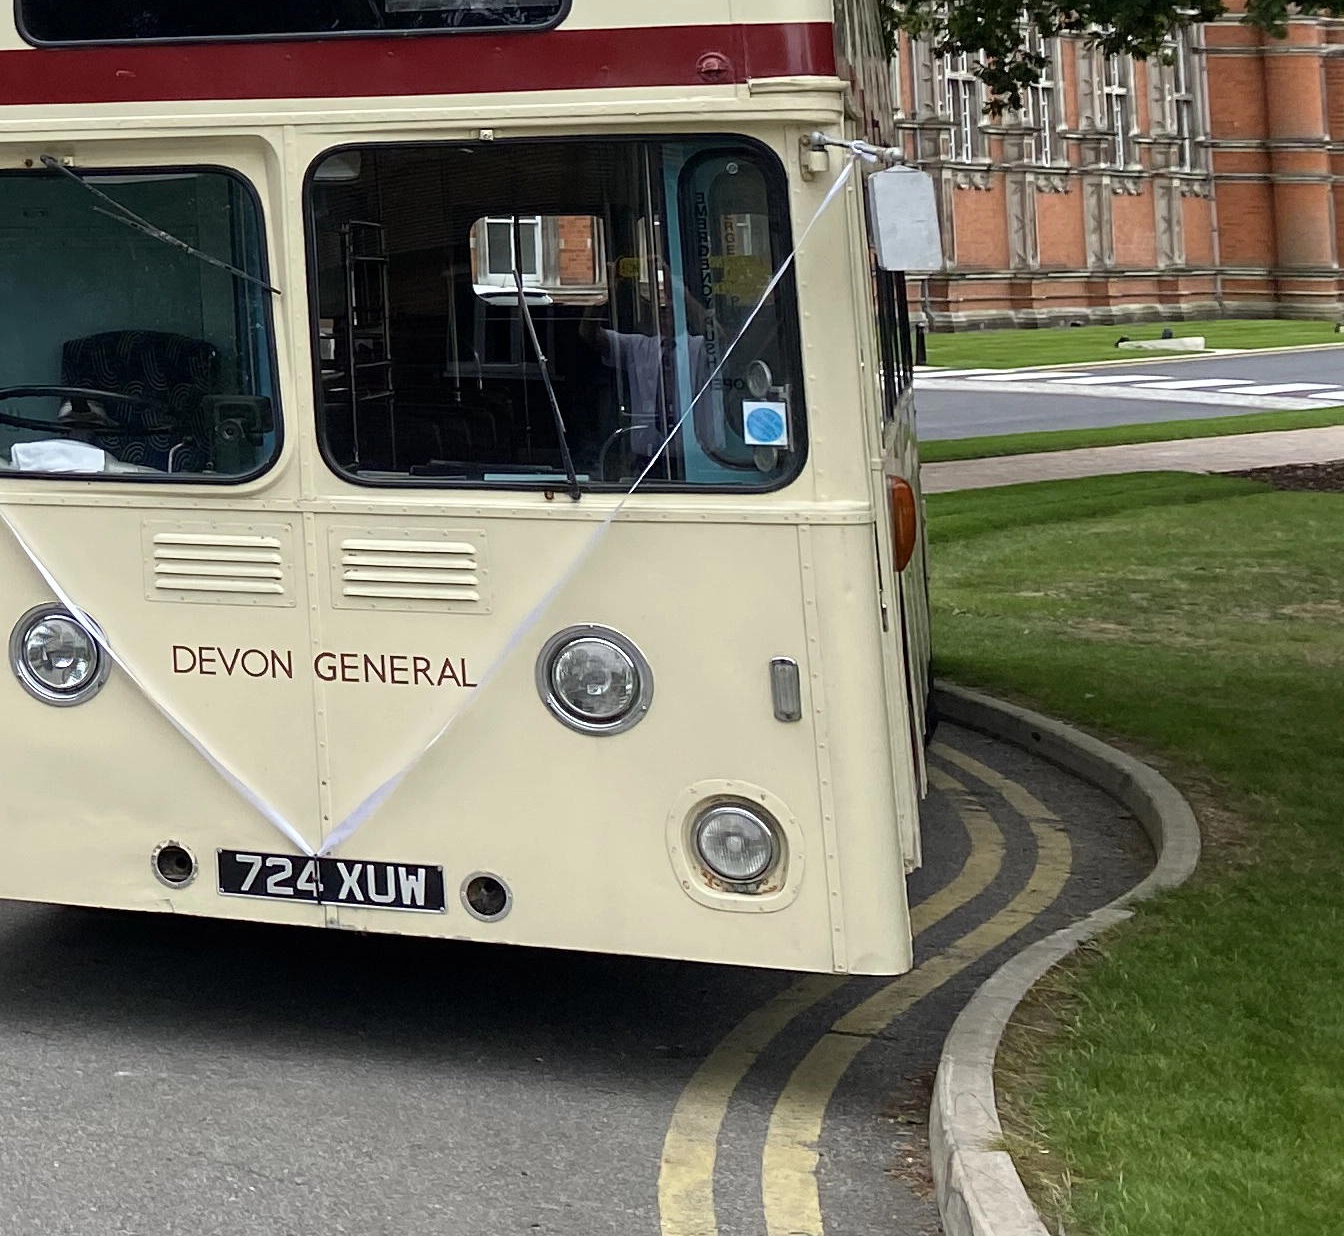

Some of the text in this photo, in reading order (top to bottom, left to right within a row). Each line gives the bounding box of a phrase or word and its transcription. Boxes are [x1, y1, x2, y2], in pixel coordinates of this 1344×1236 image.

[172, 645, 478, 687] DEVON GENERAL
[235, 853, 426, 906] 724 XUW
